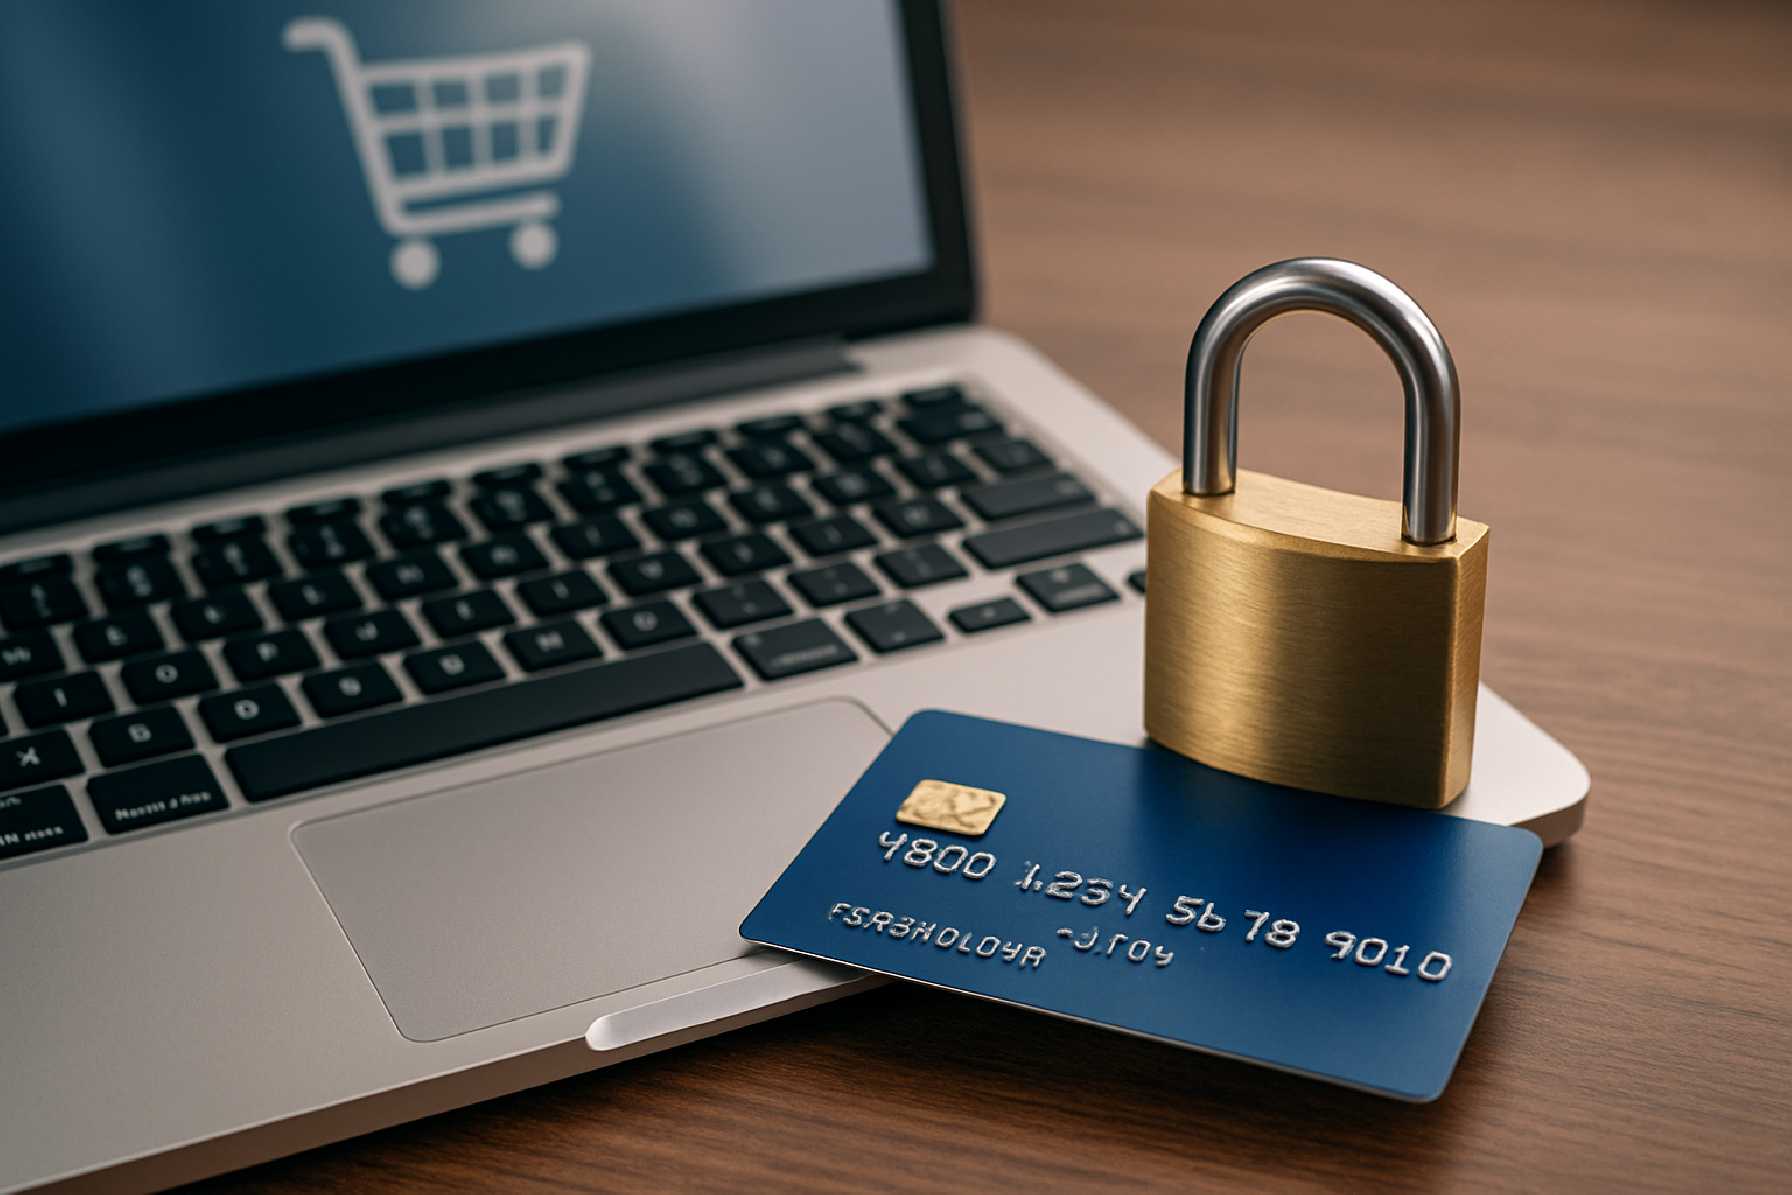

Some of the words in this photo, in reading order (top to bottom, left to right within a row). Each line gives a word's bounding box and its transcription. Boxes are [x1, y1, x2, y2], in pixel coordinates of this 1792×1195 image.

[879, 831, 997, 879] 4800
[1244, 909, 1300, 948] 78
[1324, 931, 1453, 981] 9010
